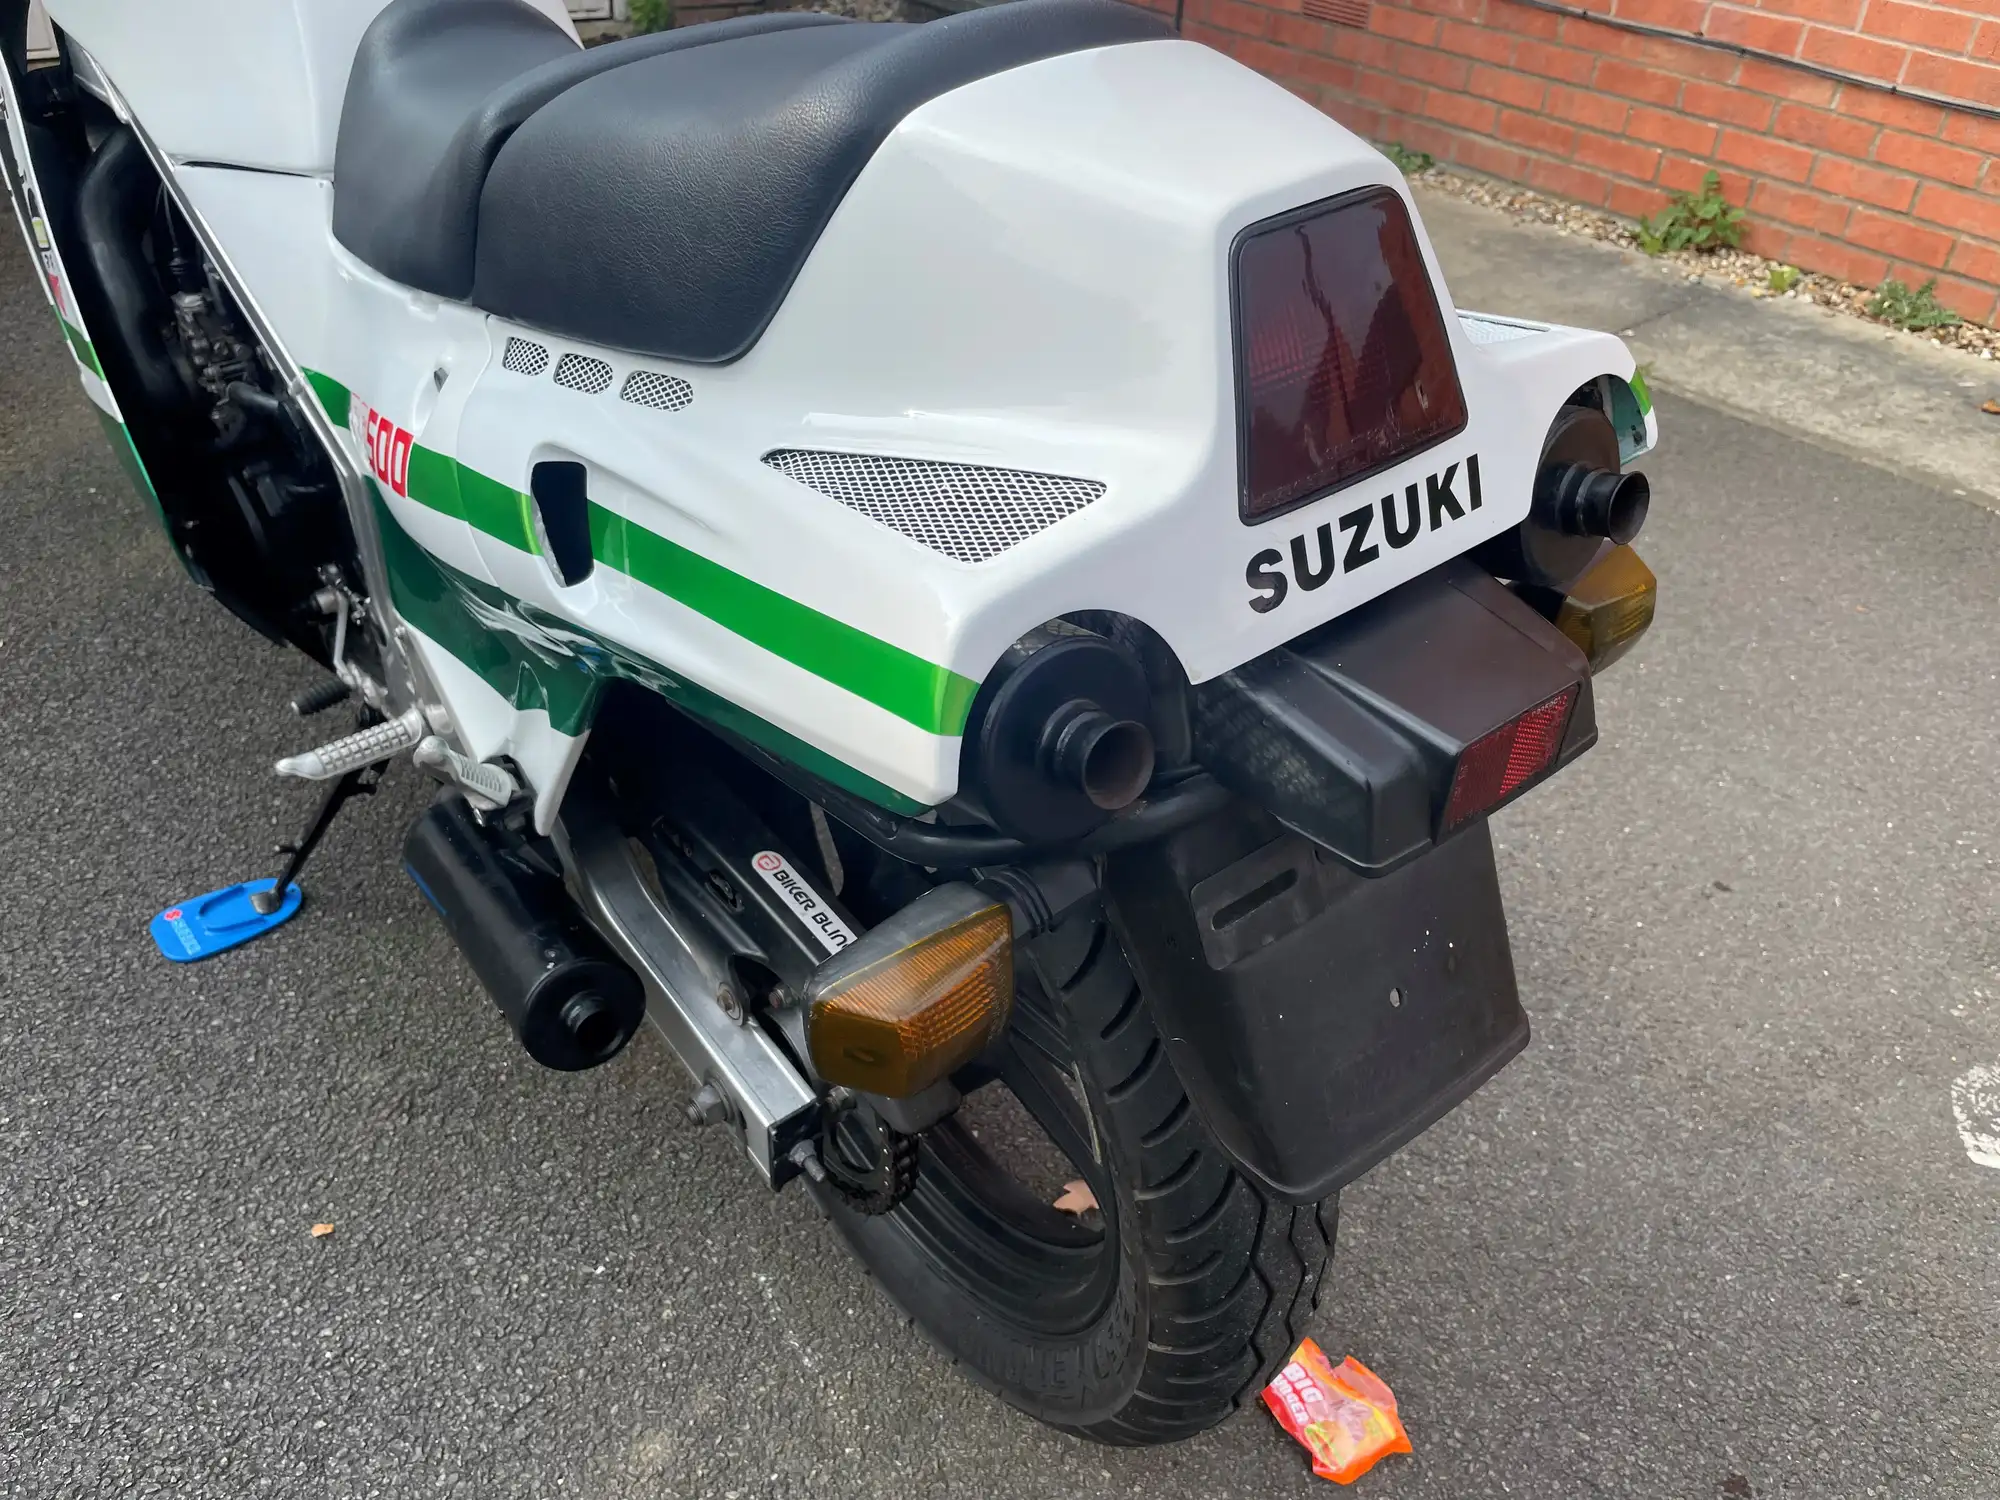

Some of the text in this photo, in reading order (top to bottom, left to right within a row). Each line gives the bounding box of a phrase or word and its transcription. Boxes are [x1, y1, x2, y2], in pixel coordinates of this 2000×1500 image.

[1246, 453, 1482, 614] SUZUKI
[773, 869, 850, 949] BIKER BLIN
